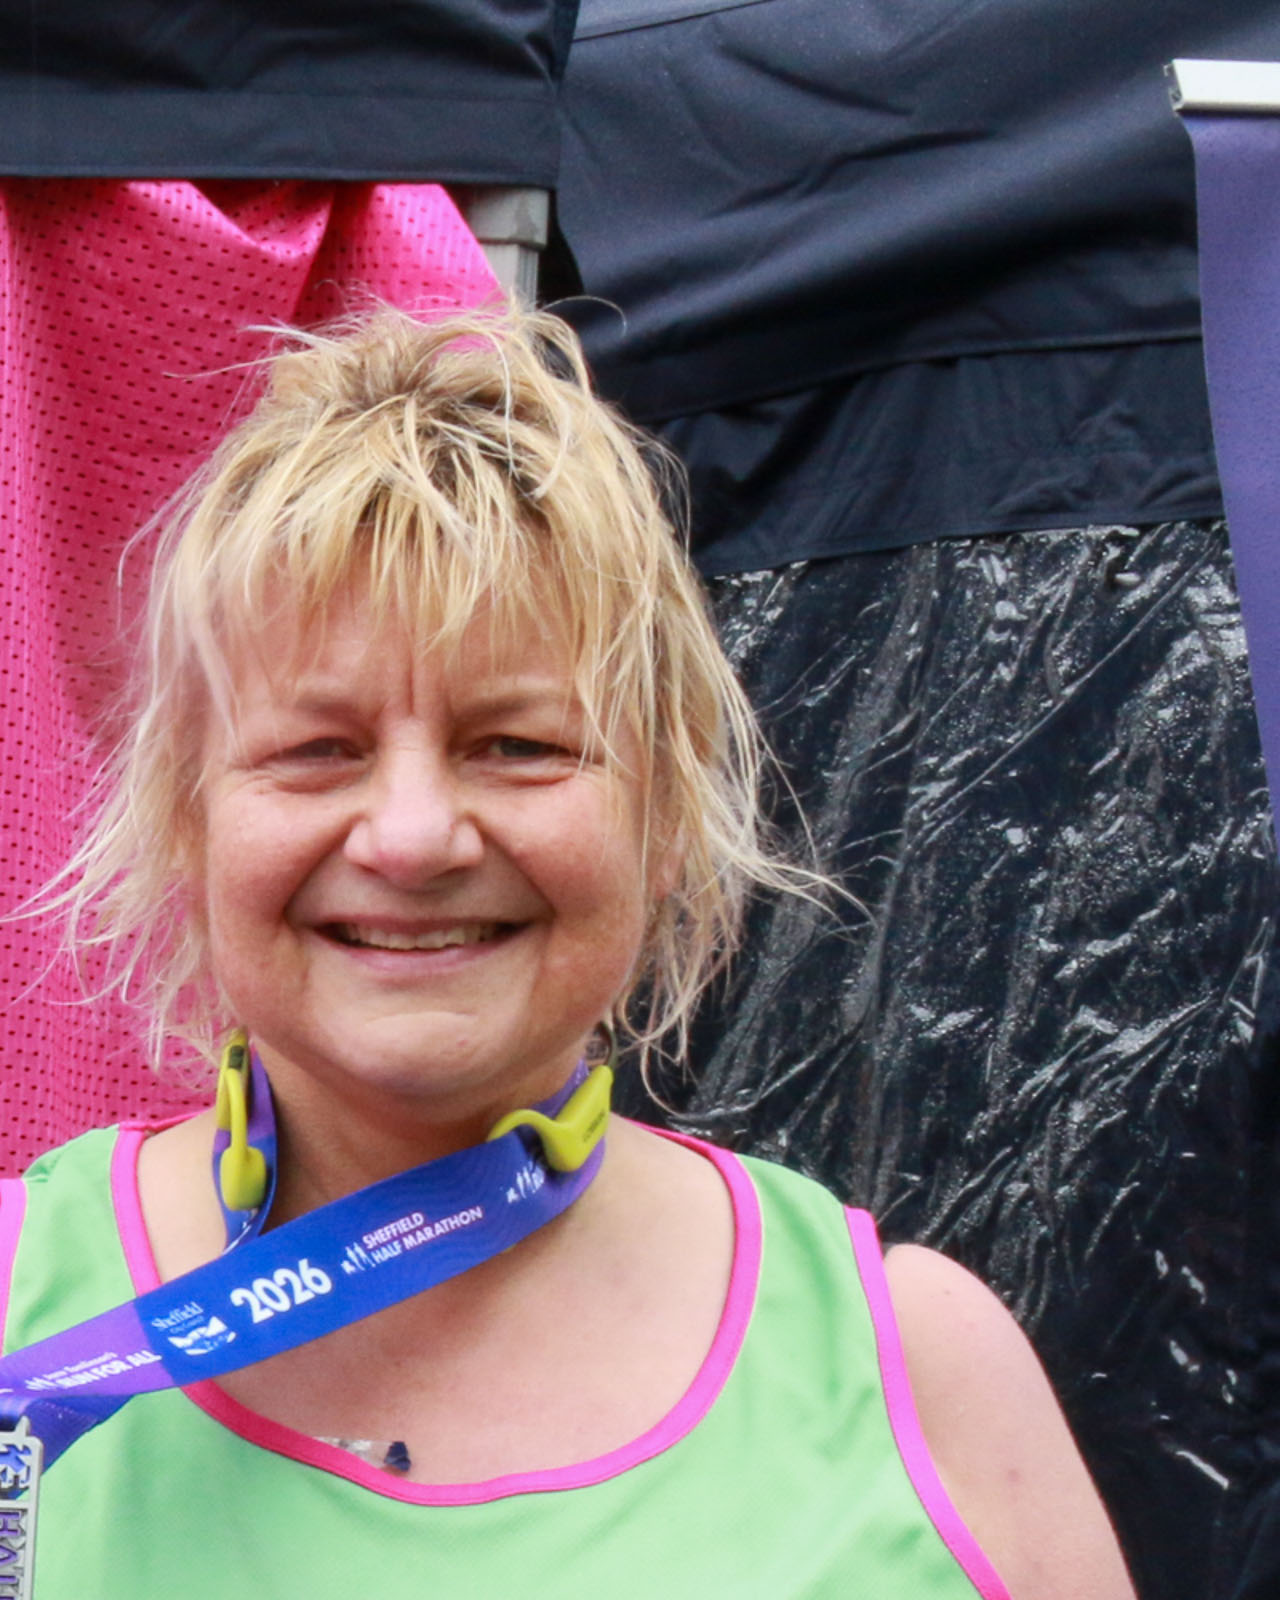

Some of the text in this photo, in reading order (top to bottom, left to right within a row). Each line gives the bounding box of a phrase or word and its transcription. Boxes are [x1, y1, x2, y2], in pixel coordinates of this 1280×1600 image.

[362, 1212, 425, 1250] SHEFFIELD
[370, 1205, 484, 1267] HALF MARATHON
[229, 1257, 332, 1324] 2026
